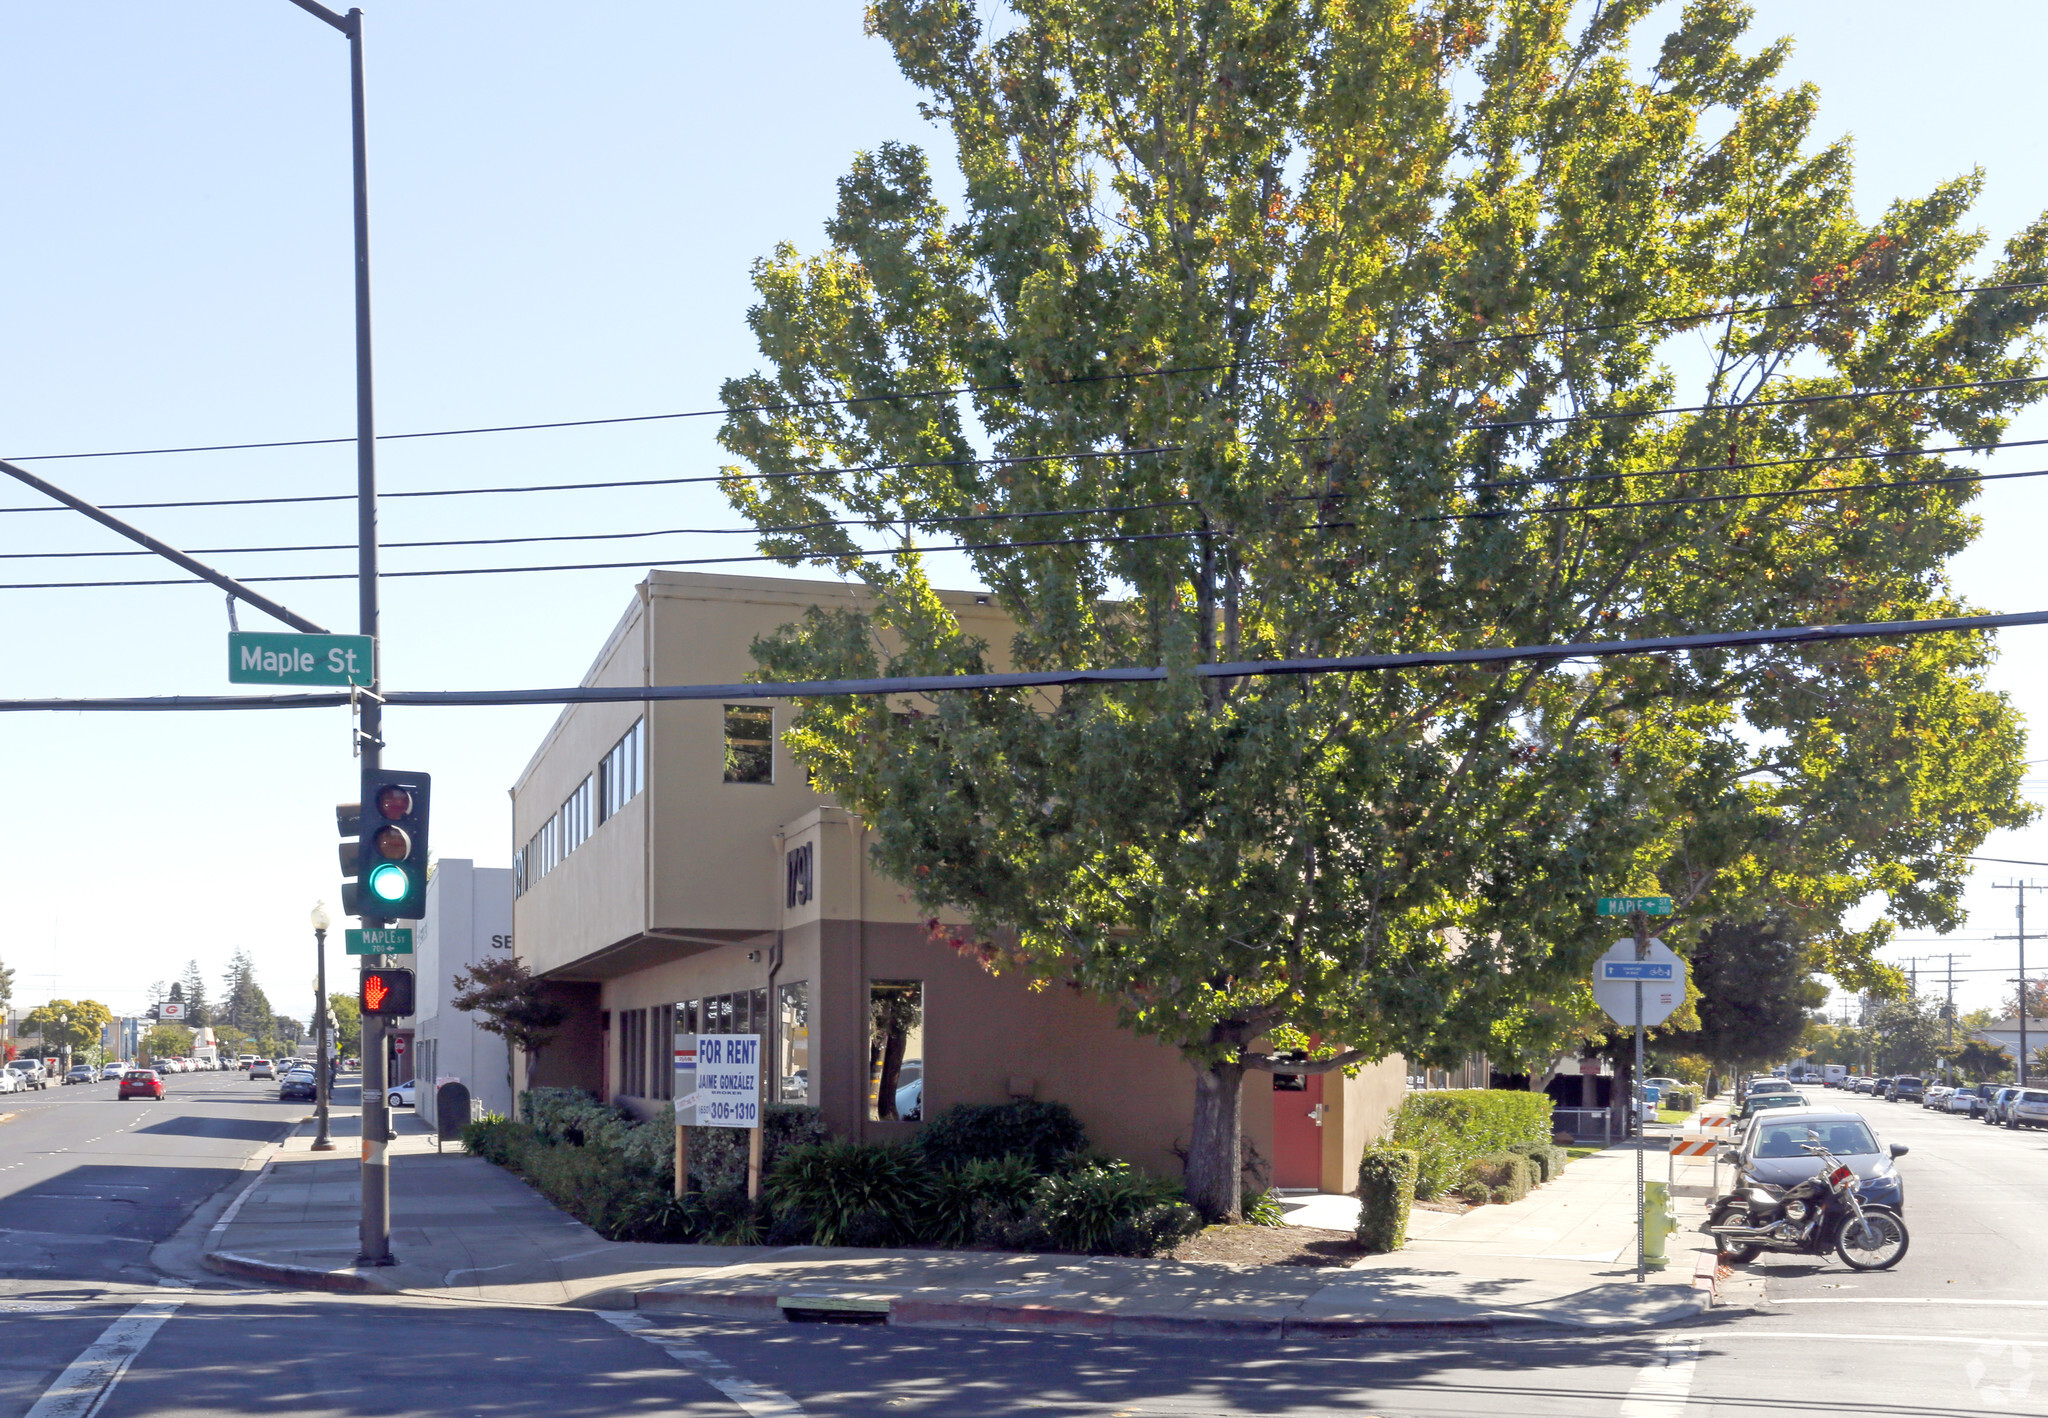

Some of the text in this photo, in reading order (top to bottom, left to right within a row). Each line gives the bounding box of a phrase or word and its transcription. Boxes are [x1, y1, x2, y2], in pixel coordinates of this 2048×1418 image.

[242, 645, 360, 676] Maple St.
[362, 931, 395, 943] MAPLE
[700, 1040, 757, 1064] FOR RENT
[698, 1072, 754, 1090] JAIME GONZÁLEZ
[711, 1102, 755, 1120] 306-1310
